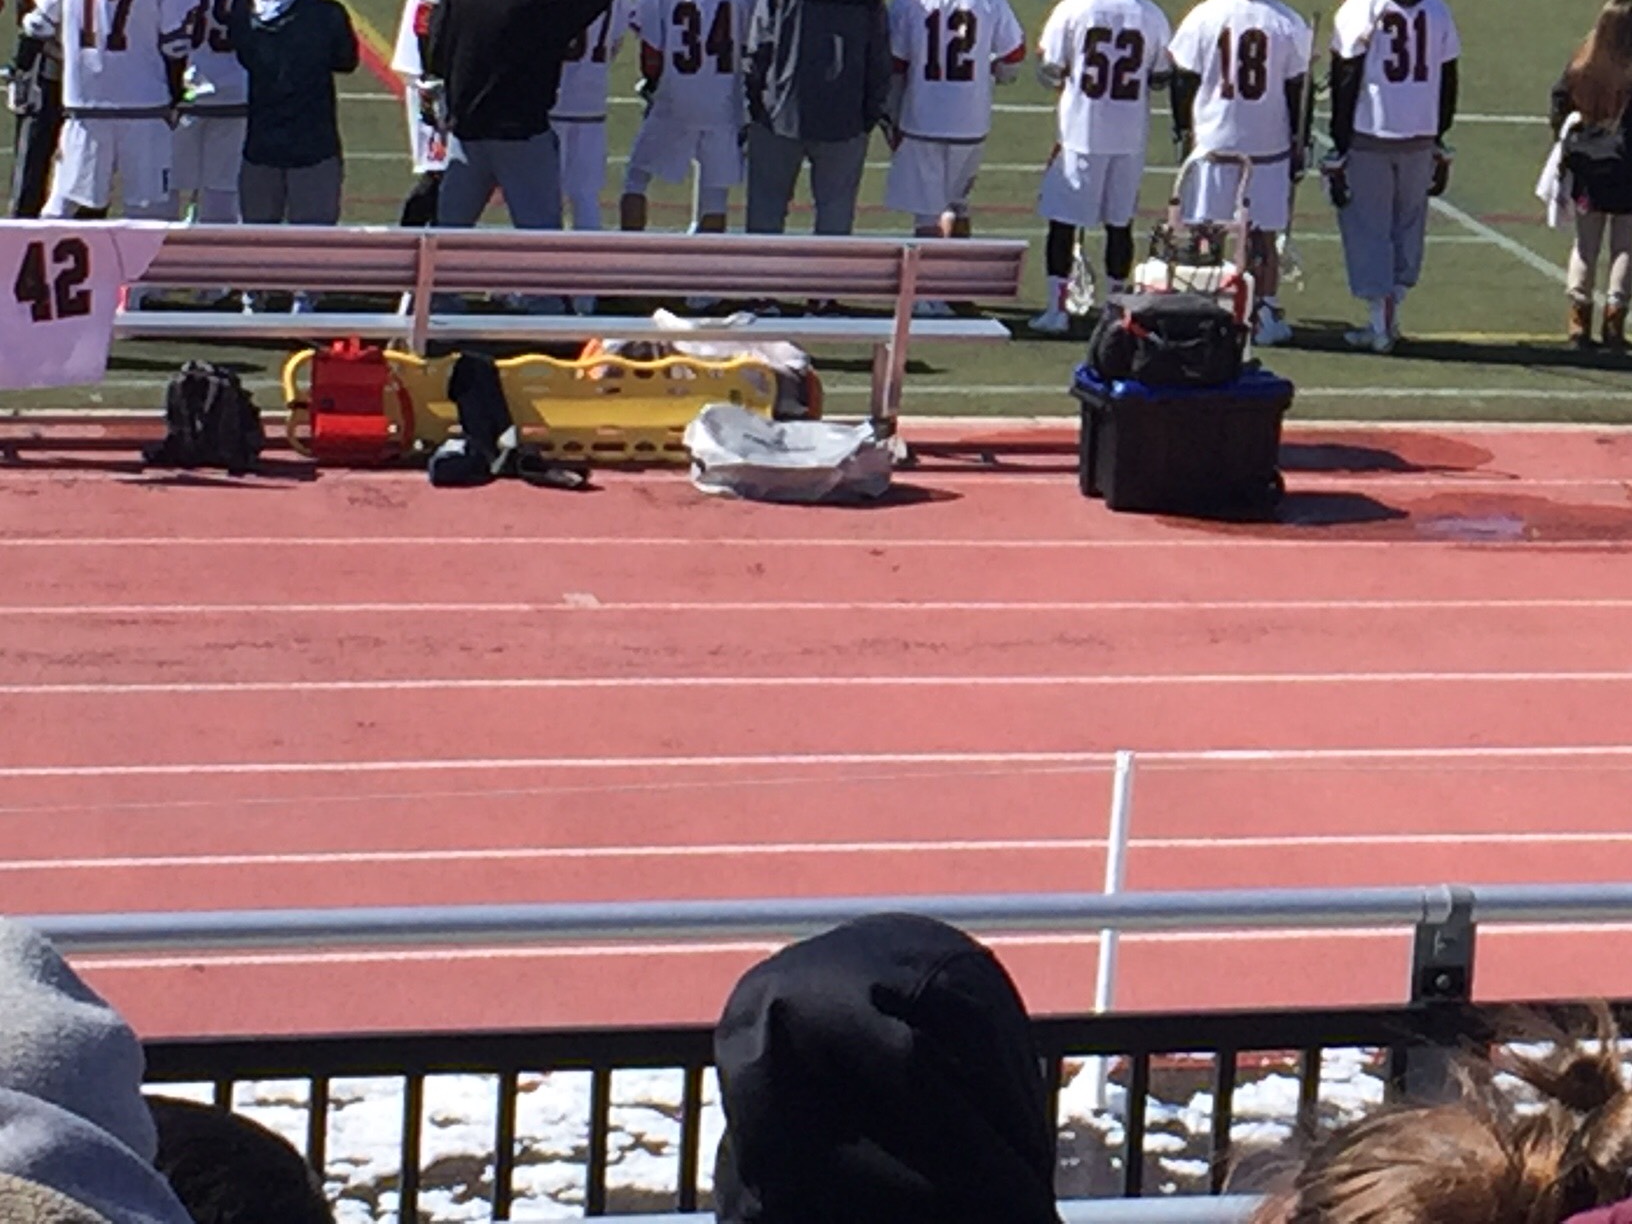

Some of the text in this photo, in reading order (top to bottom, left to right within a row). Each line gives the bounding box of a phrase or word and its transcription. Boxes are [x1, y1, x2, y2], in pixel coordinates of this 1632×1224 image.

[672, 0, 734, 75] 34
[924, 8, 977, 82] 12
[1080, 26, 1145, 101] 52
[1217, 26, 1269, 101] 18
[1383, 9, 1429, 83] 31
[14, 237, 93, 323] 42
